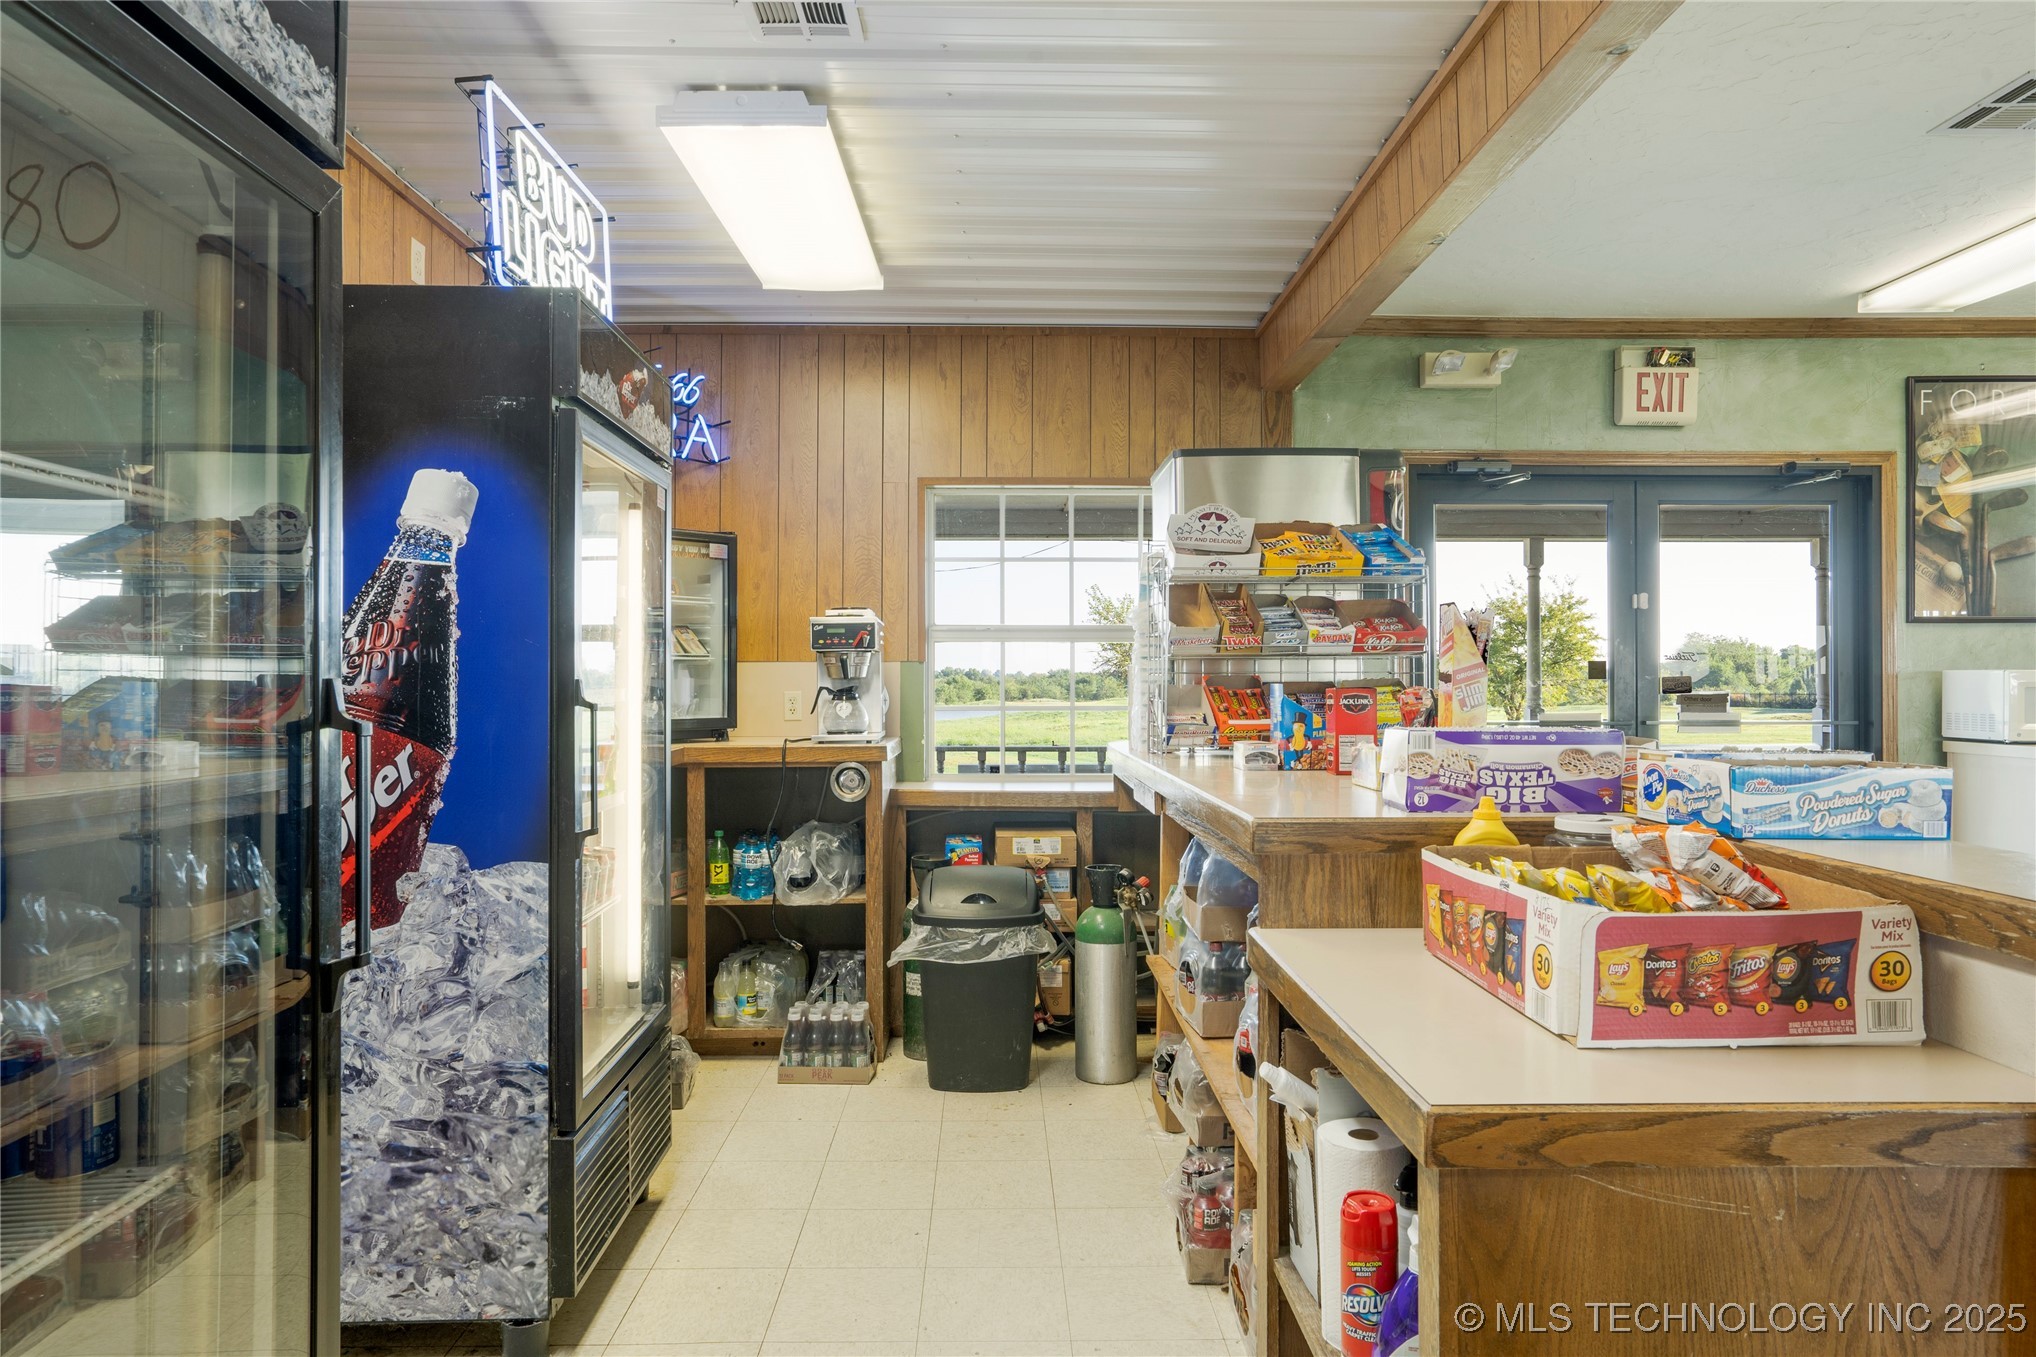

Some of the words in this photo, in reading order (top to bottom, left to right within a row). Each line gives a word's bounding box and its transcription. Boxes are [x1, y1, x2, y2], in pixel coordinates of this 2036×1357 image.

[515, 130, 595, 264] BUD
[1636, 372, 1689, 412] EXIT
[1222, 635, 1261, 646] Twix
[1455, 667, 1485, 680] ORIGINAL
[1439, 769, 1471, 782] TEXAS
[1439, 776, 1467, 788] BIG
[1479, 769, 1554, 787] TEXAS
[1652, 780, 1663, 795] Pie
[1745, 781, 1787, 794] Duchess
[1417, 796, 1425, 805] 12
[1485, 787, 1546, 804] BIG
[1800, 795, 1865, 817] Powdered
[1866, 783, 1907, 805] Sugar
[1812, 808, 1873, 834] Donuts
[1743, 824, 1754, 834] 12
[1533, 906, 1558, 928] Variety
[1872, 917, 1912, 930] Variety
[1538, 923, 1551, 938] Mix
[1881, 930, 1904, 941] Mix
[1537, 953, 1550, 975] 30
[1646, 960, 1677, 969] Doritos
[1688, 951, 1721, 974] Cheetos
[1812, 956, 1841, 965] Doritos
[1608, 963, 1629, 975] Lay's
[1732, 957, 1766, 979] Fritos
[1777, 962, 1796, 974] Lay's
[1880, 960, 1905, 977] 30
[1882, 978, 1898, 986] Bags
[1633, 1005, 1639, 1013] 9
[1342, 1294, 1388, 1313] RESOLV
